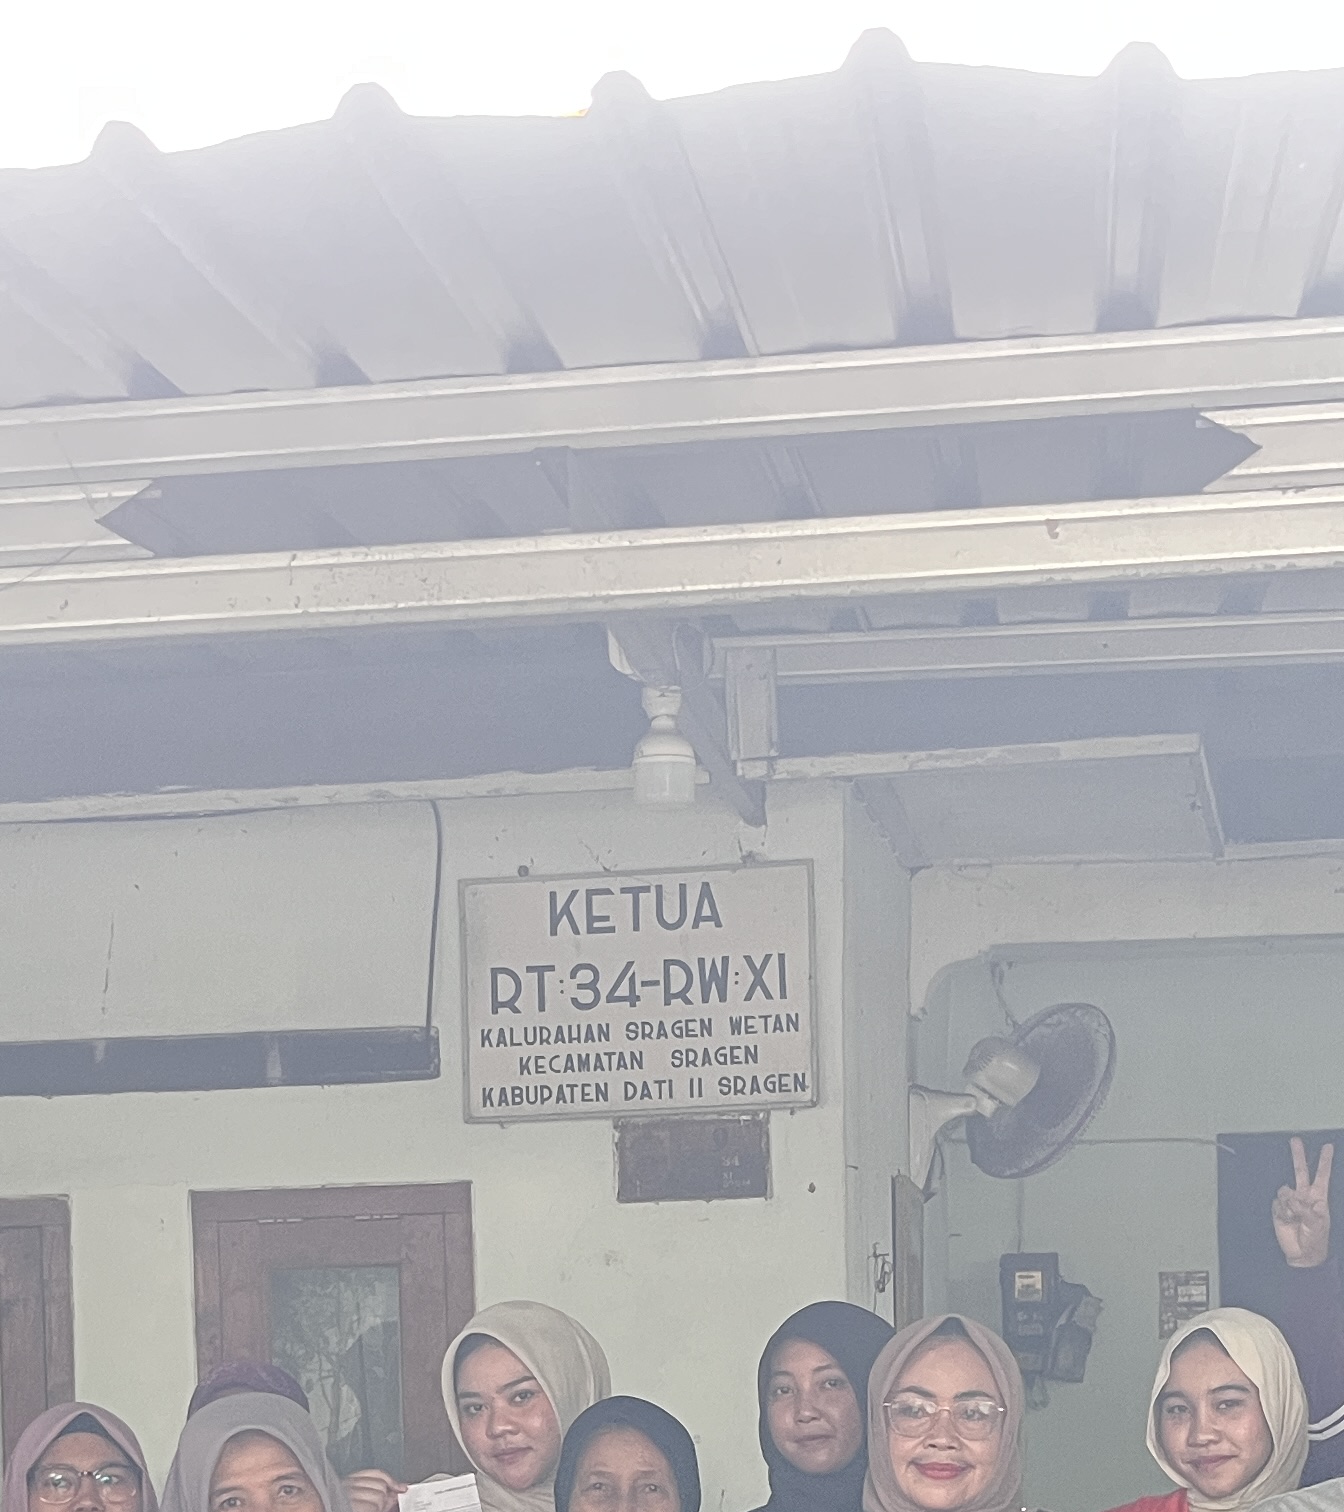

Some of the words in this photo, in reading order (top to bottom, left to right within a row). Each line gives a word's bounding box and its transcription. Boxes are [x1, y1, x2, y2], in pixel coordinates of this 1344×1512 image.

[548, 881, 723, 937] KETUA
[480, 1022, 611, 1048] KALURAHAN
[625, 1018, 713, 1042] SRAGEN
[728, 1013, 800, 1035] WETAN
[518, 1050, 644, 1076] KECAMATAN
[670, 1045, 759, 1069] SRAGEN
[481, 1081, 609, 1108] KABUPATEN
[623, 1079, 673, 1102] DATI
[689, 1077, 703, 1098] II
[717, 1072, 807, 1096] SRAGEN
